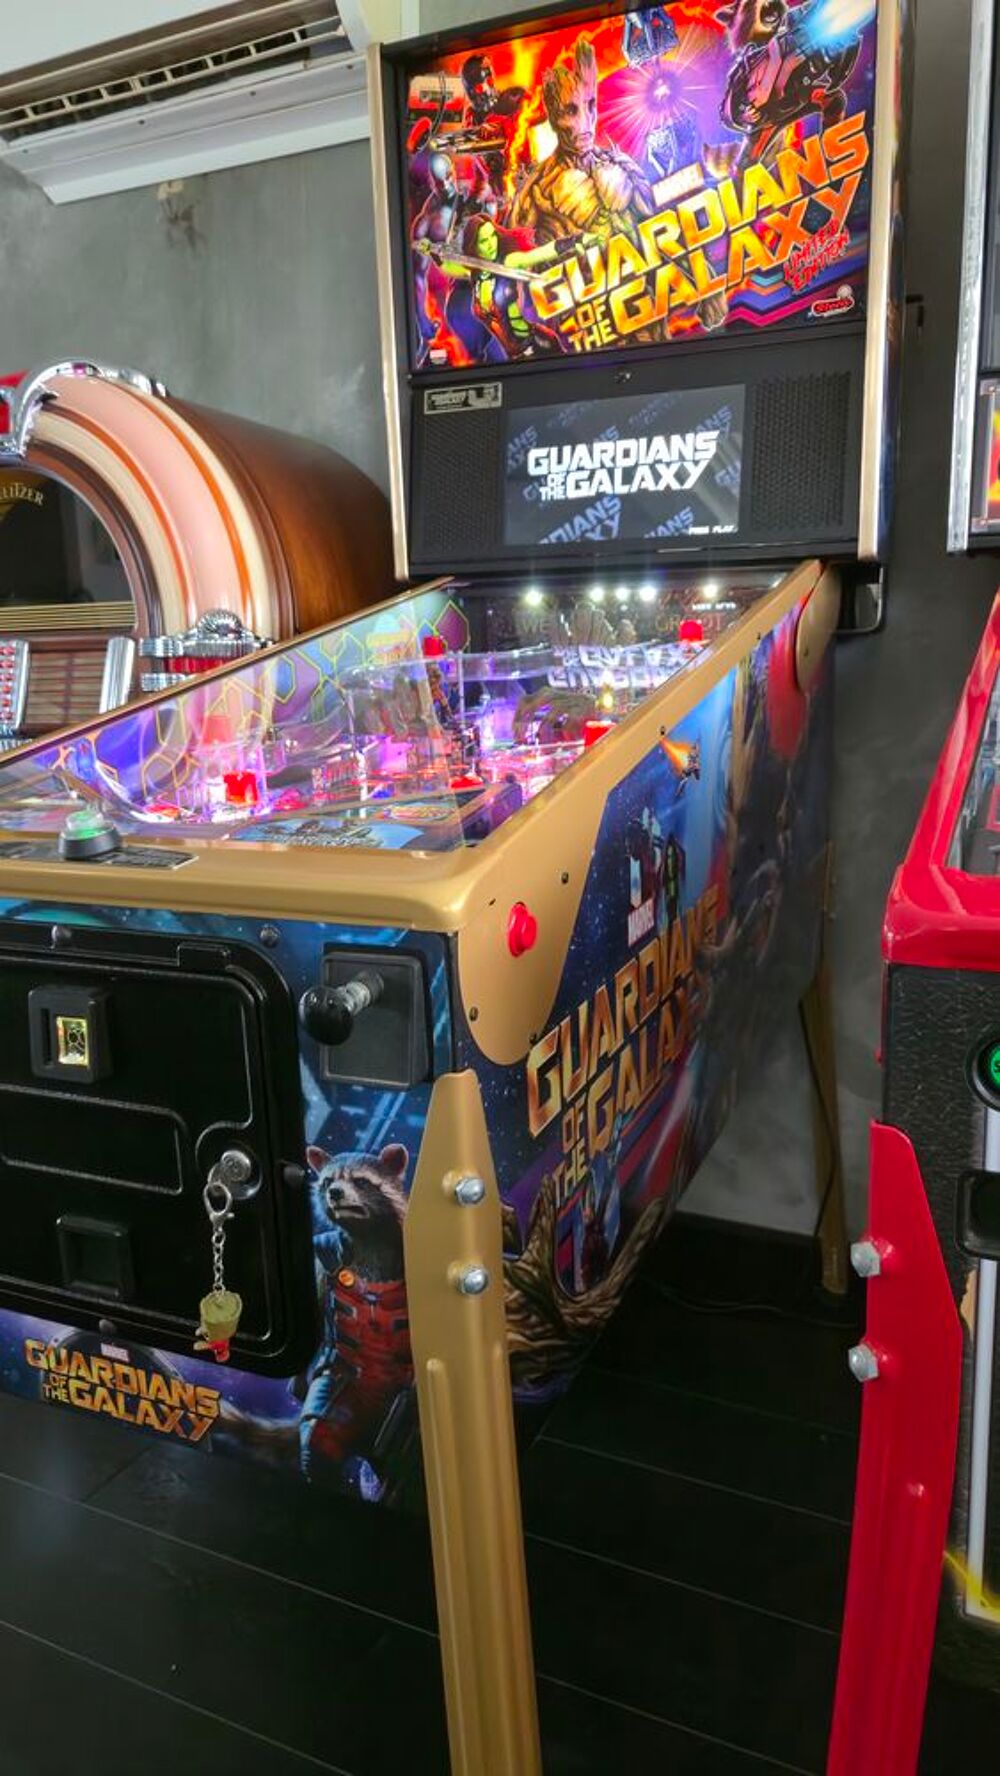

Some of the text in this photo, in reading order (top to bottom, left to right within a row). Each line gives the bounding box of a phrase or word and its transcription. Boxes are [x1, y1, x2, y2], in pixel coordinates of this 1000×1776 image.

[529, 111, 869, 320] GUARDIANS
[610, 171, 863, 335] GALAXY
[568, 318, 618, 351] THE
[576, 295, 608, 328] OF
[527, 430, 720, 477] GUARDIANS
[538, 485, 567, 501] THE
[546, 473, 566, 487] OF
[566, 460, 710, 499] GALAXY
[526, 884, 719, 1138] GUARDIANS
[562, 1091, 586, 1154] OF
[552, 1136, 588, 1210] THE
[25, 1339, 220, 1418] GUARDIANS
[43, 1384, 69, 1403] THE
[51, 1372, 69, 1388] OF
[68, 1378, 212, 1442] GALAXY
